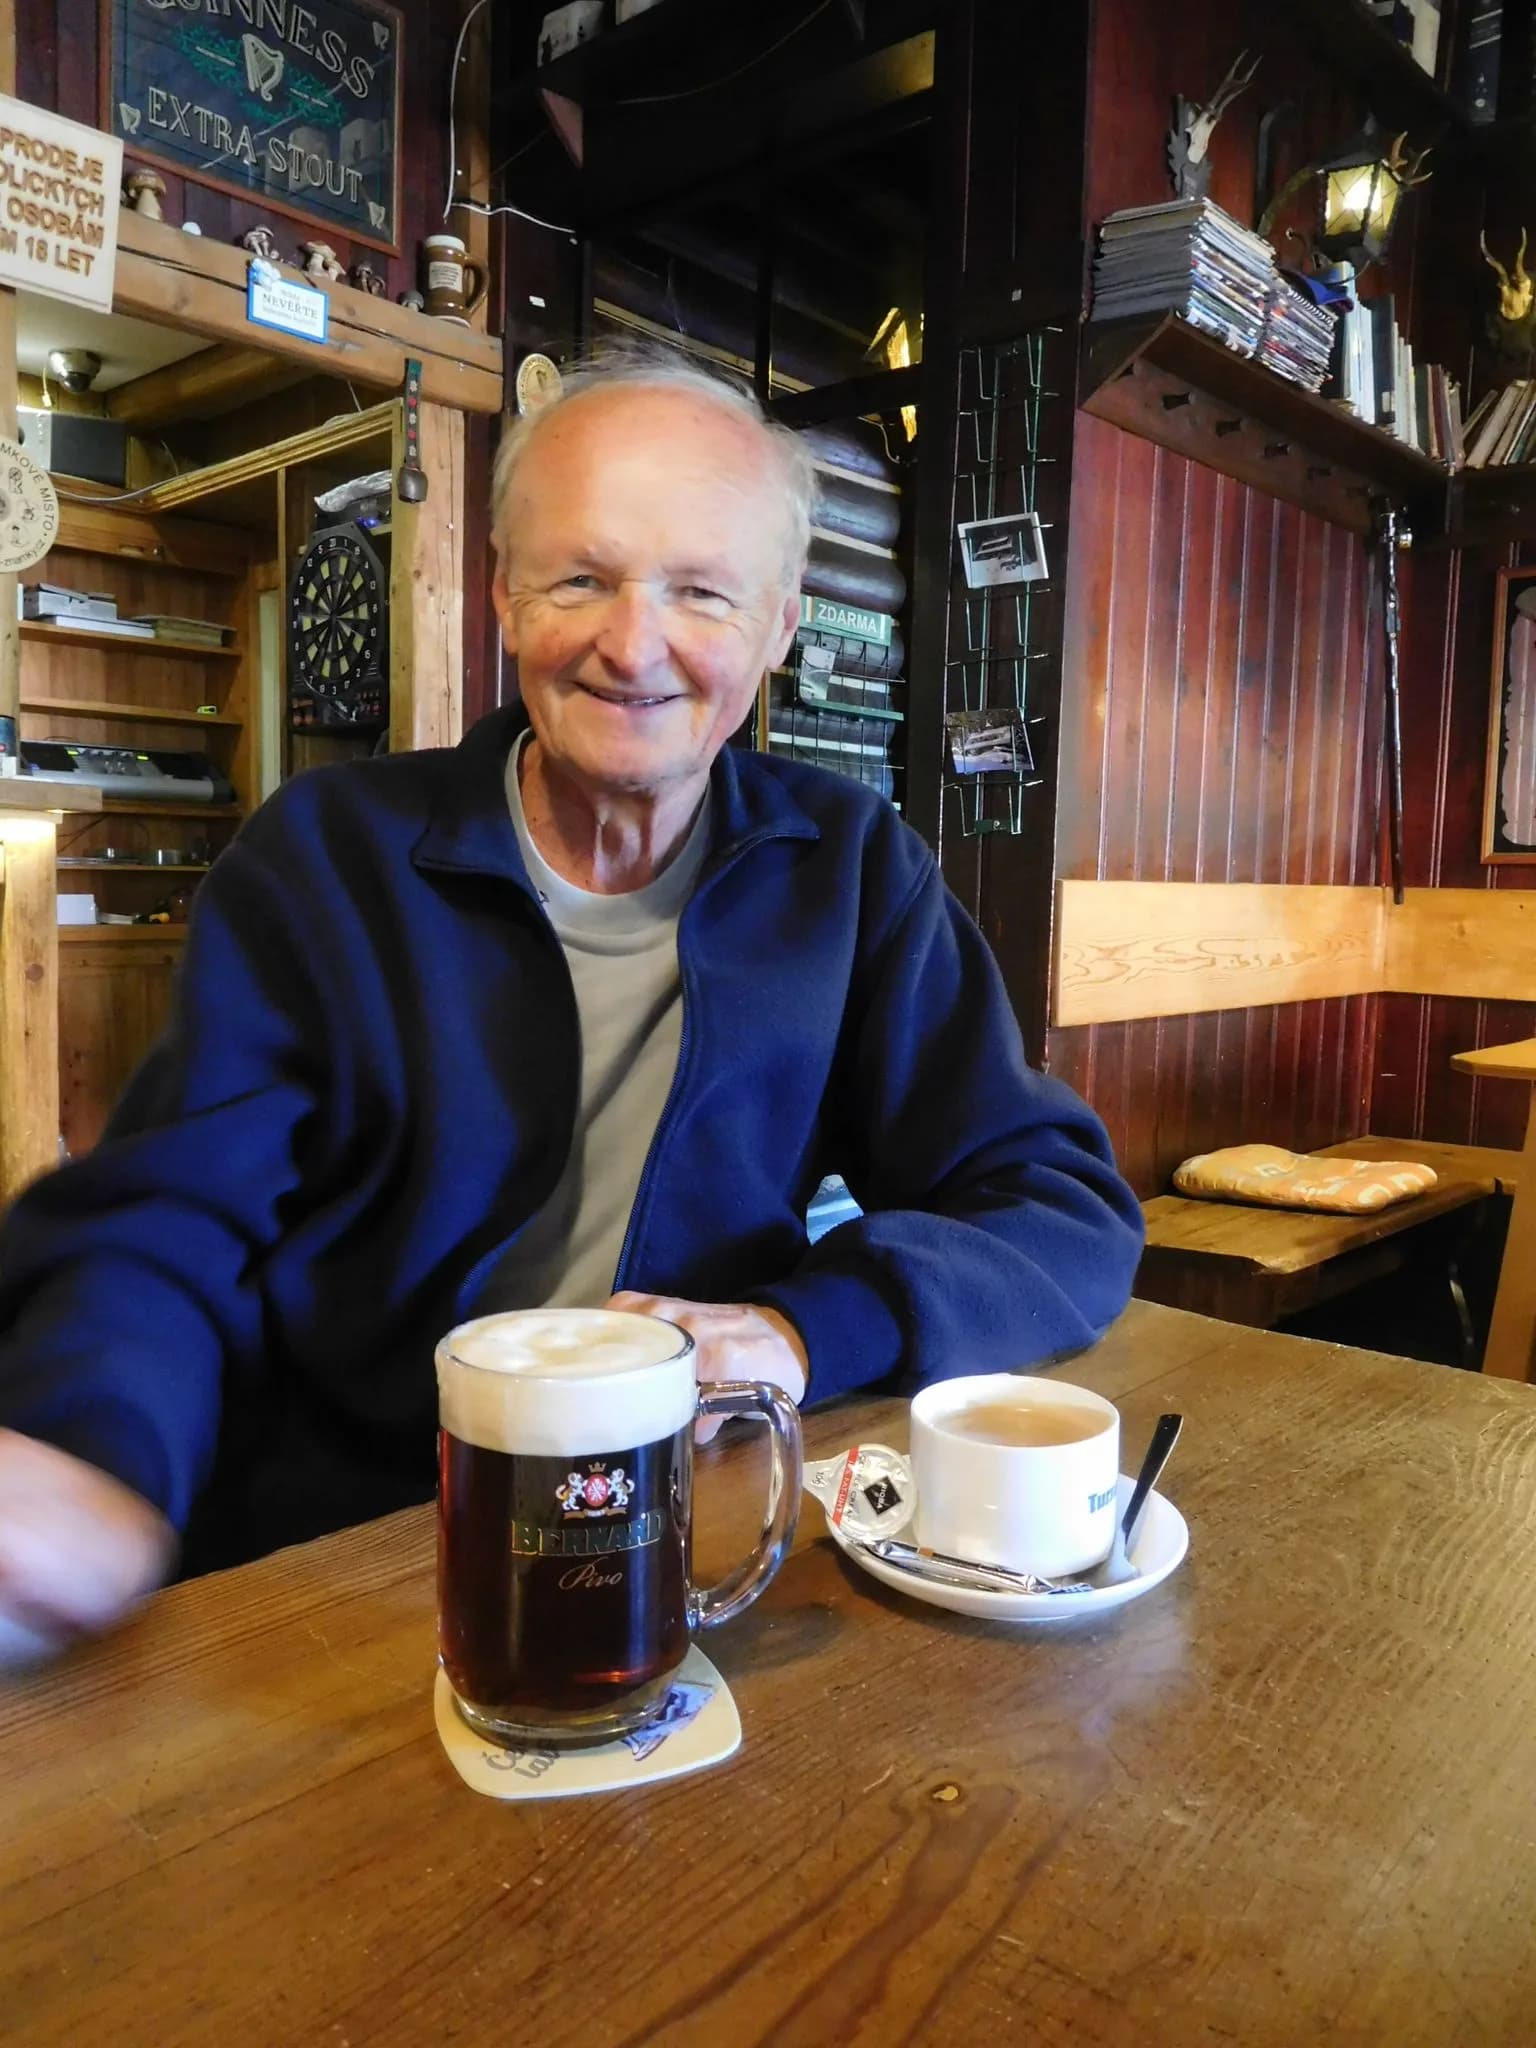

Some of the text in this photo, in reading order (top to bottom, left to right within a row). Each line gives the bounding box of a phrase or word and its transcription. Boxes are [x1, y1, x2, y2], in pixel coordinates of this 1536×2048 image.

[148, 86, 363, 204] EXTRA STOUT
[6, 195, 104, 249] OSOBÁM
[24, 234, 49, 265] 18
[54, 243, 96, 277] LET
[817, 603, 878, 633] ZDARMA
[558, 1556, 624, 1591] Pivo
